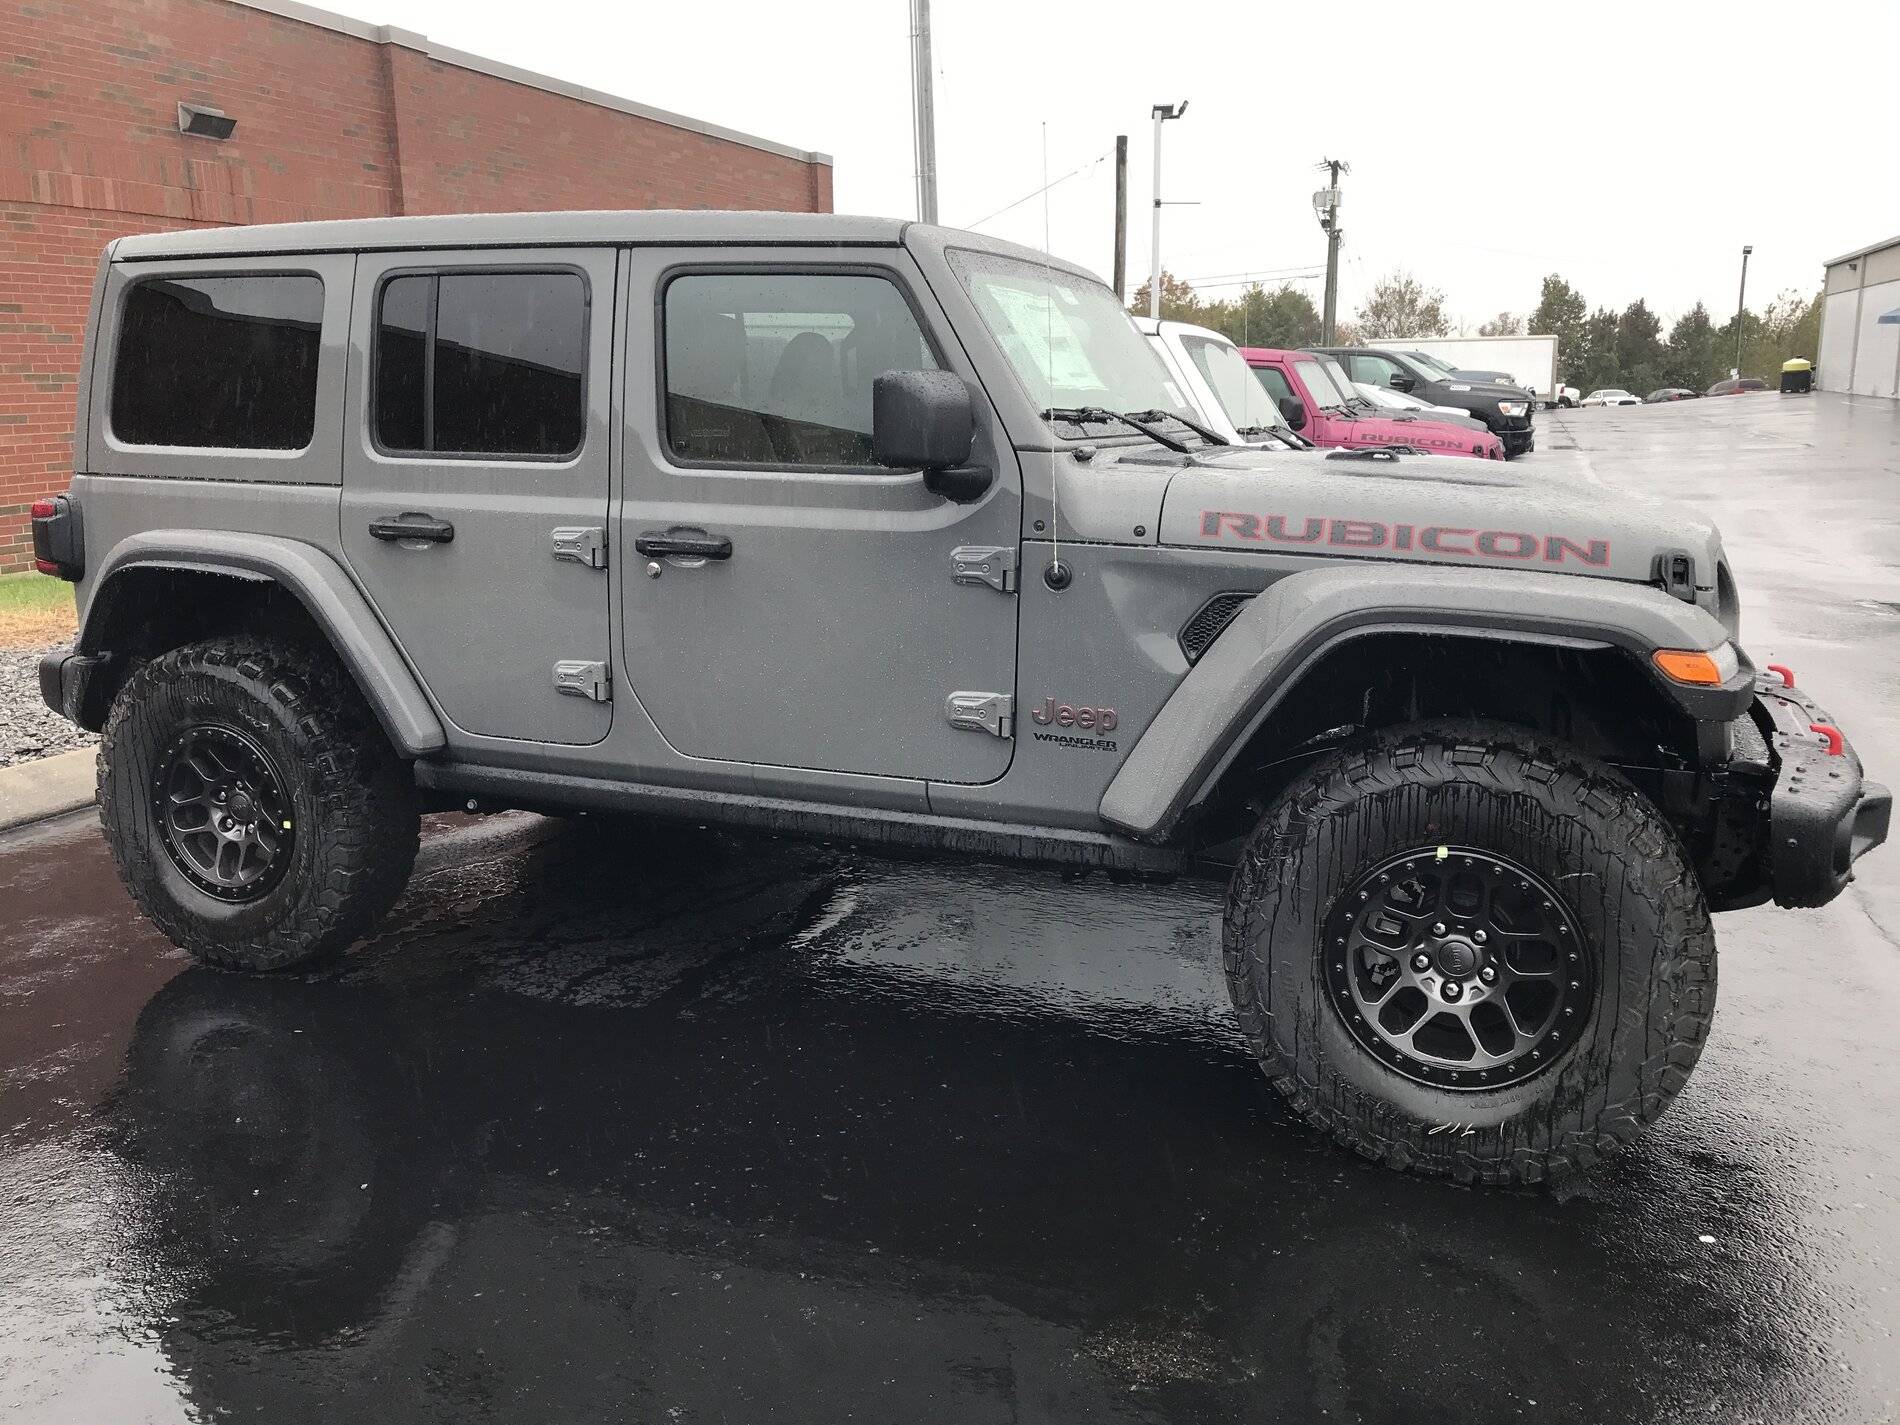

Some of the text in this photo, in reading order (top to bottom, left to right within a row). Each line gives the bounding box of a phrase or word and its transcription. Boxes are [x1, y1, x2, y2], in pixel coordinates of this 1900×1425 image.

[1360, 433, 1464, 449] RUBICON
[1200, 511, 1611, 567] RUBICON
[1031, 695, 1118, 736] Jeep
[1033, 732, 1117, 748] WRANGLER
[1059, 742, 1118, 752] UNLIMITED
